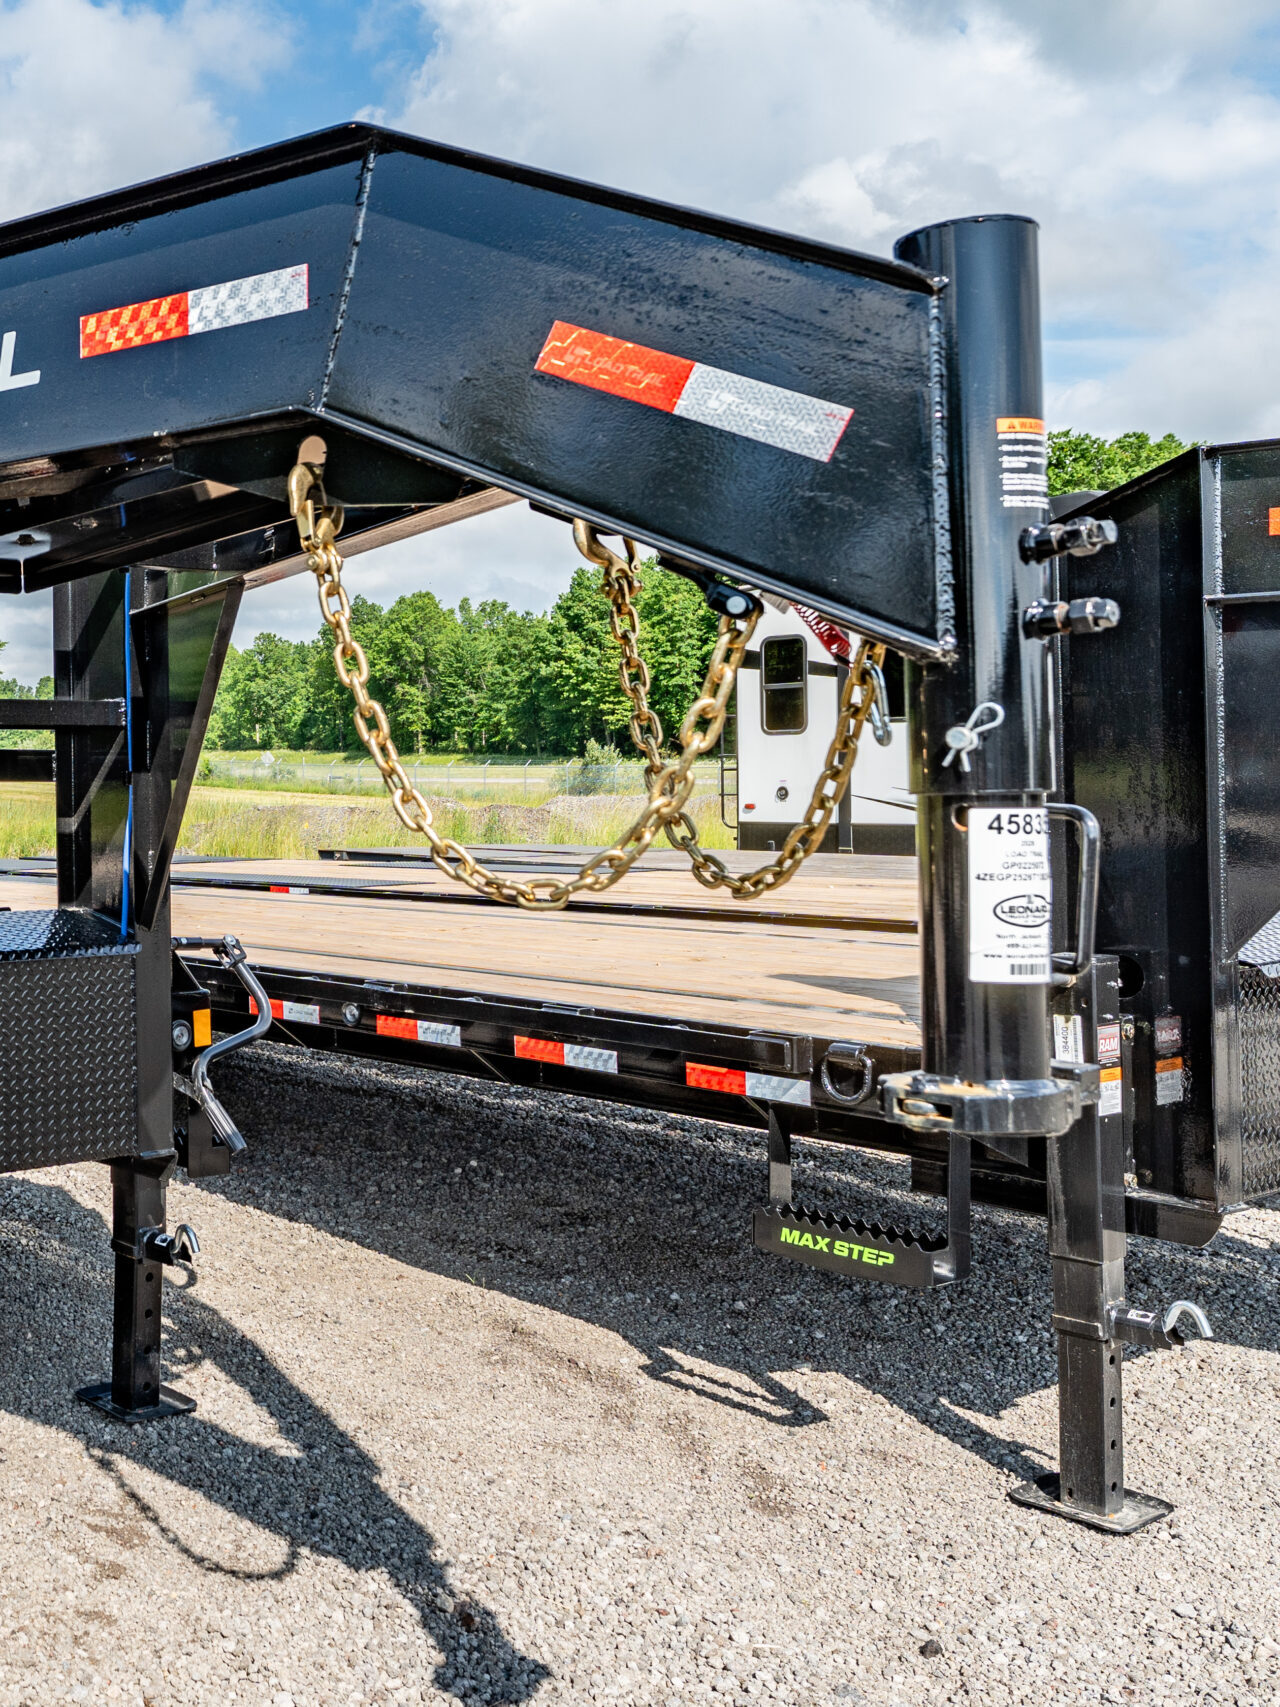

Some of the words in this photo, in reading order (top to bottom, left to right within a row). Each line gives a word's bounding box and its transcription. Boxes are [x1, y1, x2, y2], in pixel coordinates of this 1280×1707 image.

[1099, 1037, 1118, 1052] RAM
[780, 1227, 831, 1253] MAX
[833, 1240, 895, 1266] STEP
